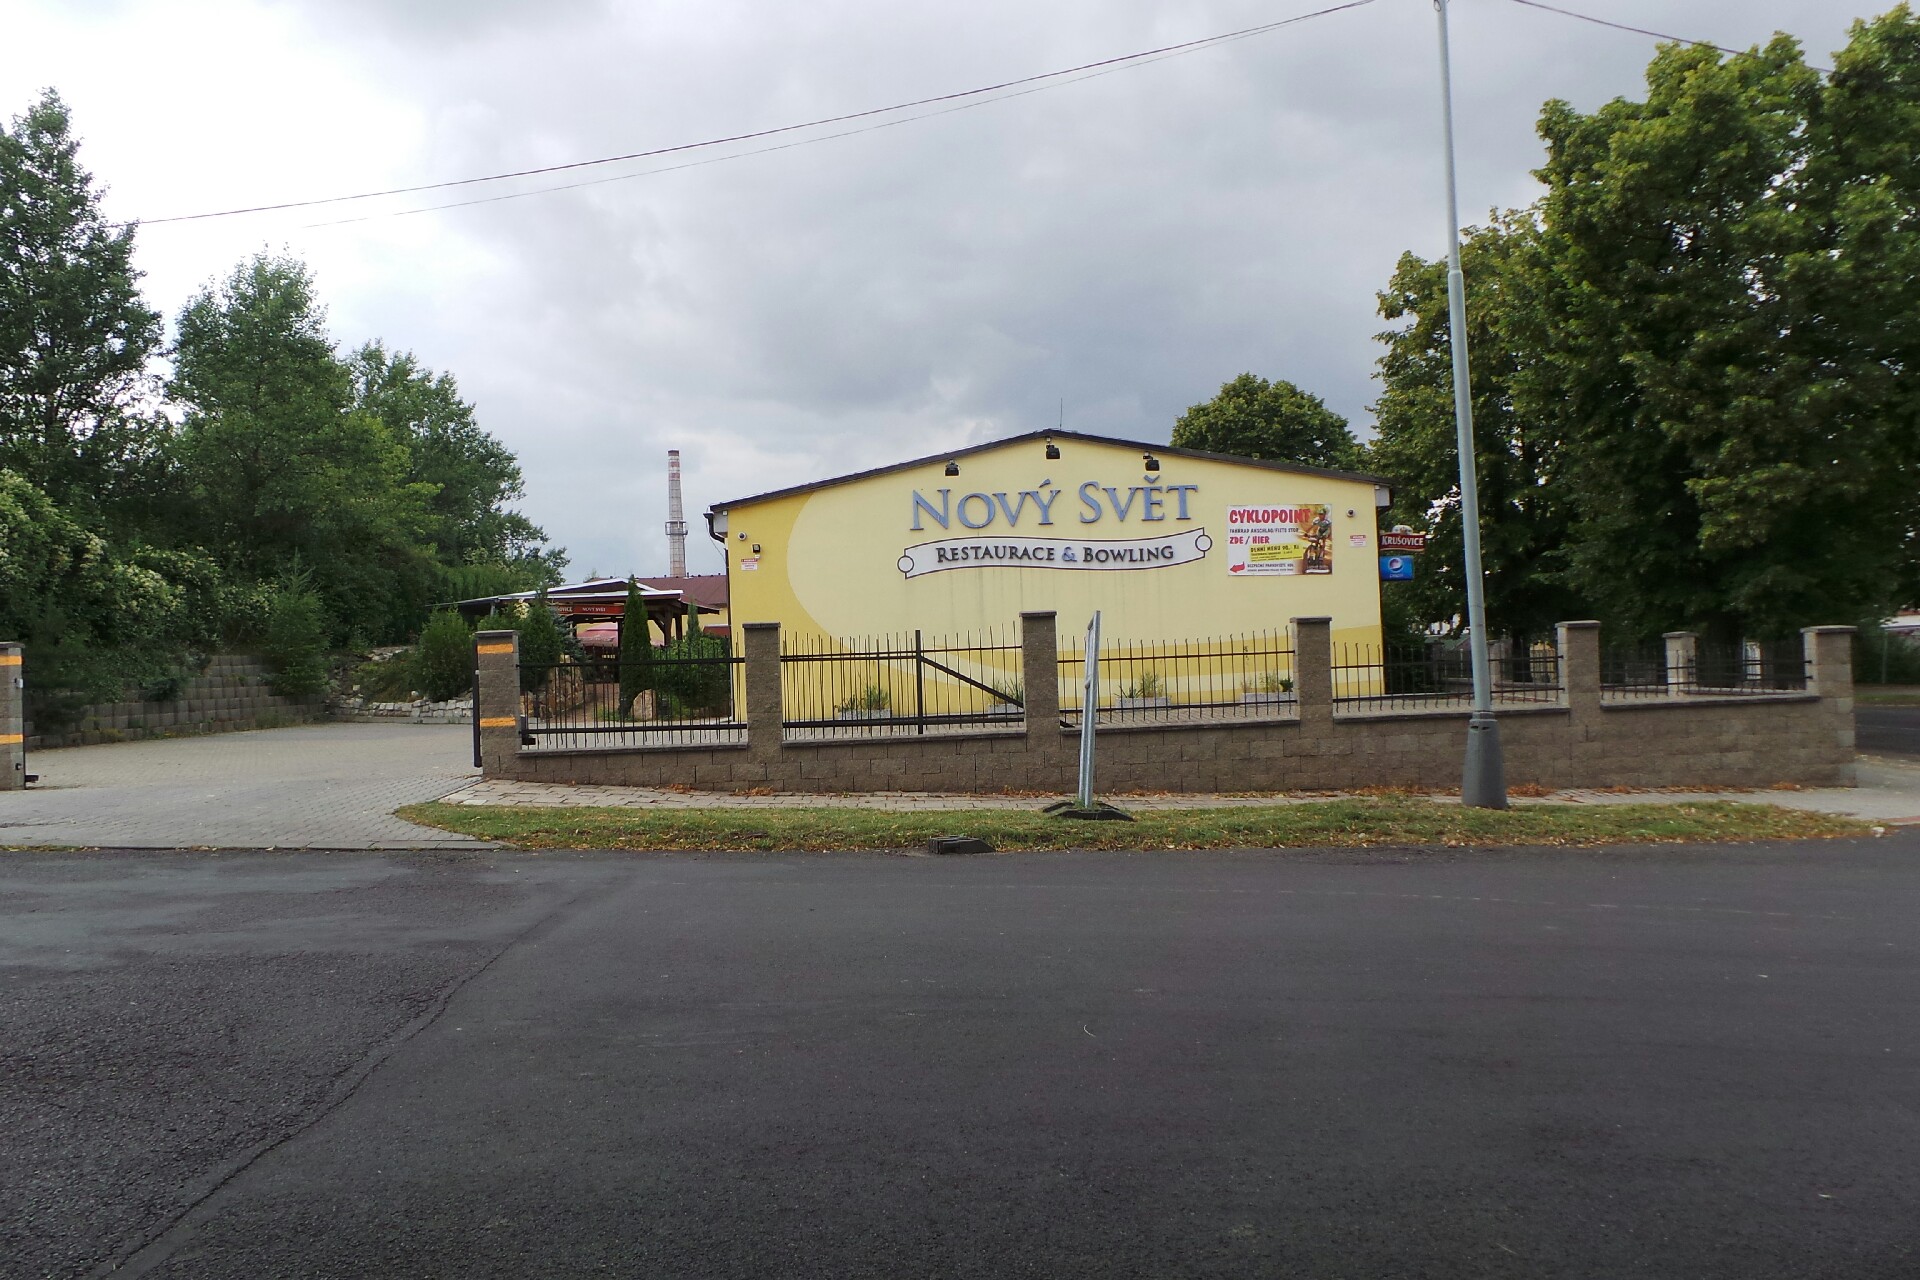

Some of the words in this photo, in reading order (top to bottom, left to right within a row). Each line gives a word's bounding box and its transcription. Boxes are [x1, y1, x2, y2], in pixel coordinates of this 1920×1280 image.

[910, 479, 1061, 531] NOVÝ
[1079, 475, 1198, 523] SVĚT
[1229, 509, 1311, 524] CYKLOPOINT
[1229, 536, 1244, 545] ZDE
[1252, 536, 1270, 544] HIER
[1381, 535, 1424, 546] KRUŠOVICE
[936, 546, 1055, 563] RESTAURACE
[1061, 546, 1077, 562] &
[1082, 545, 1175, 563] BOWLING
